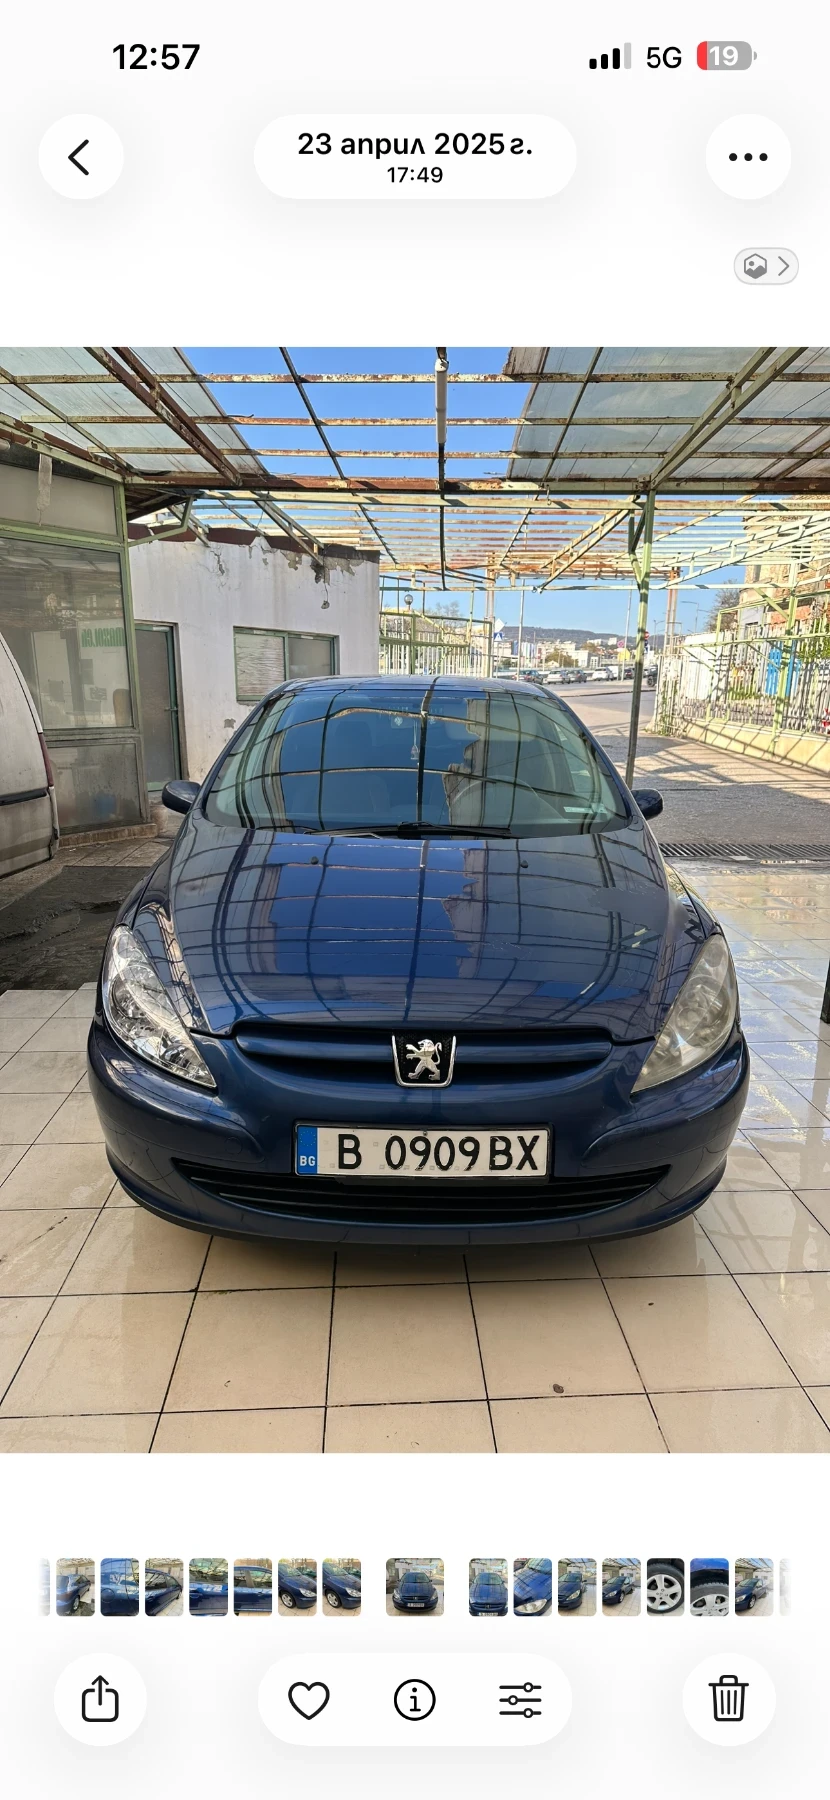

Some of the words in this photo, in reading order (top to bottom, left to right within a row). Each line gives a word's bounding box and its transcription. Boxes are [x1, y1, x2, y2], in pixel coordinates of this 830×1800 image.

[112, 43, 201, 71] 12:57
[646, 46, 682, 69] 5G
[709, 45, 739, 67] 19
[298, 132, 332, 156] 23
[340, 137, 426, 160] април
[434, 132, 505, 156] 2025
[387, 166, 444, 184] 17:49
[299, 1155, 316, 1167] BG
[337, 1133, 362, 1170] B
